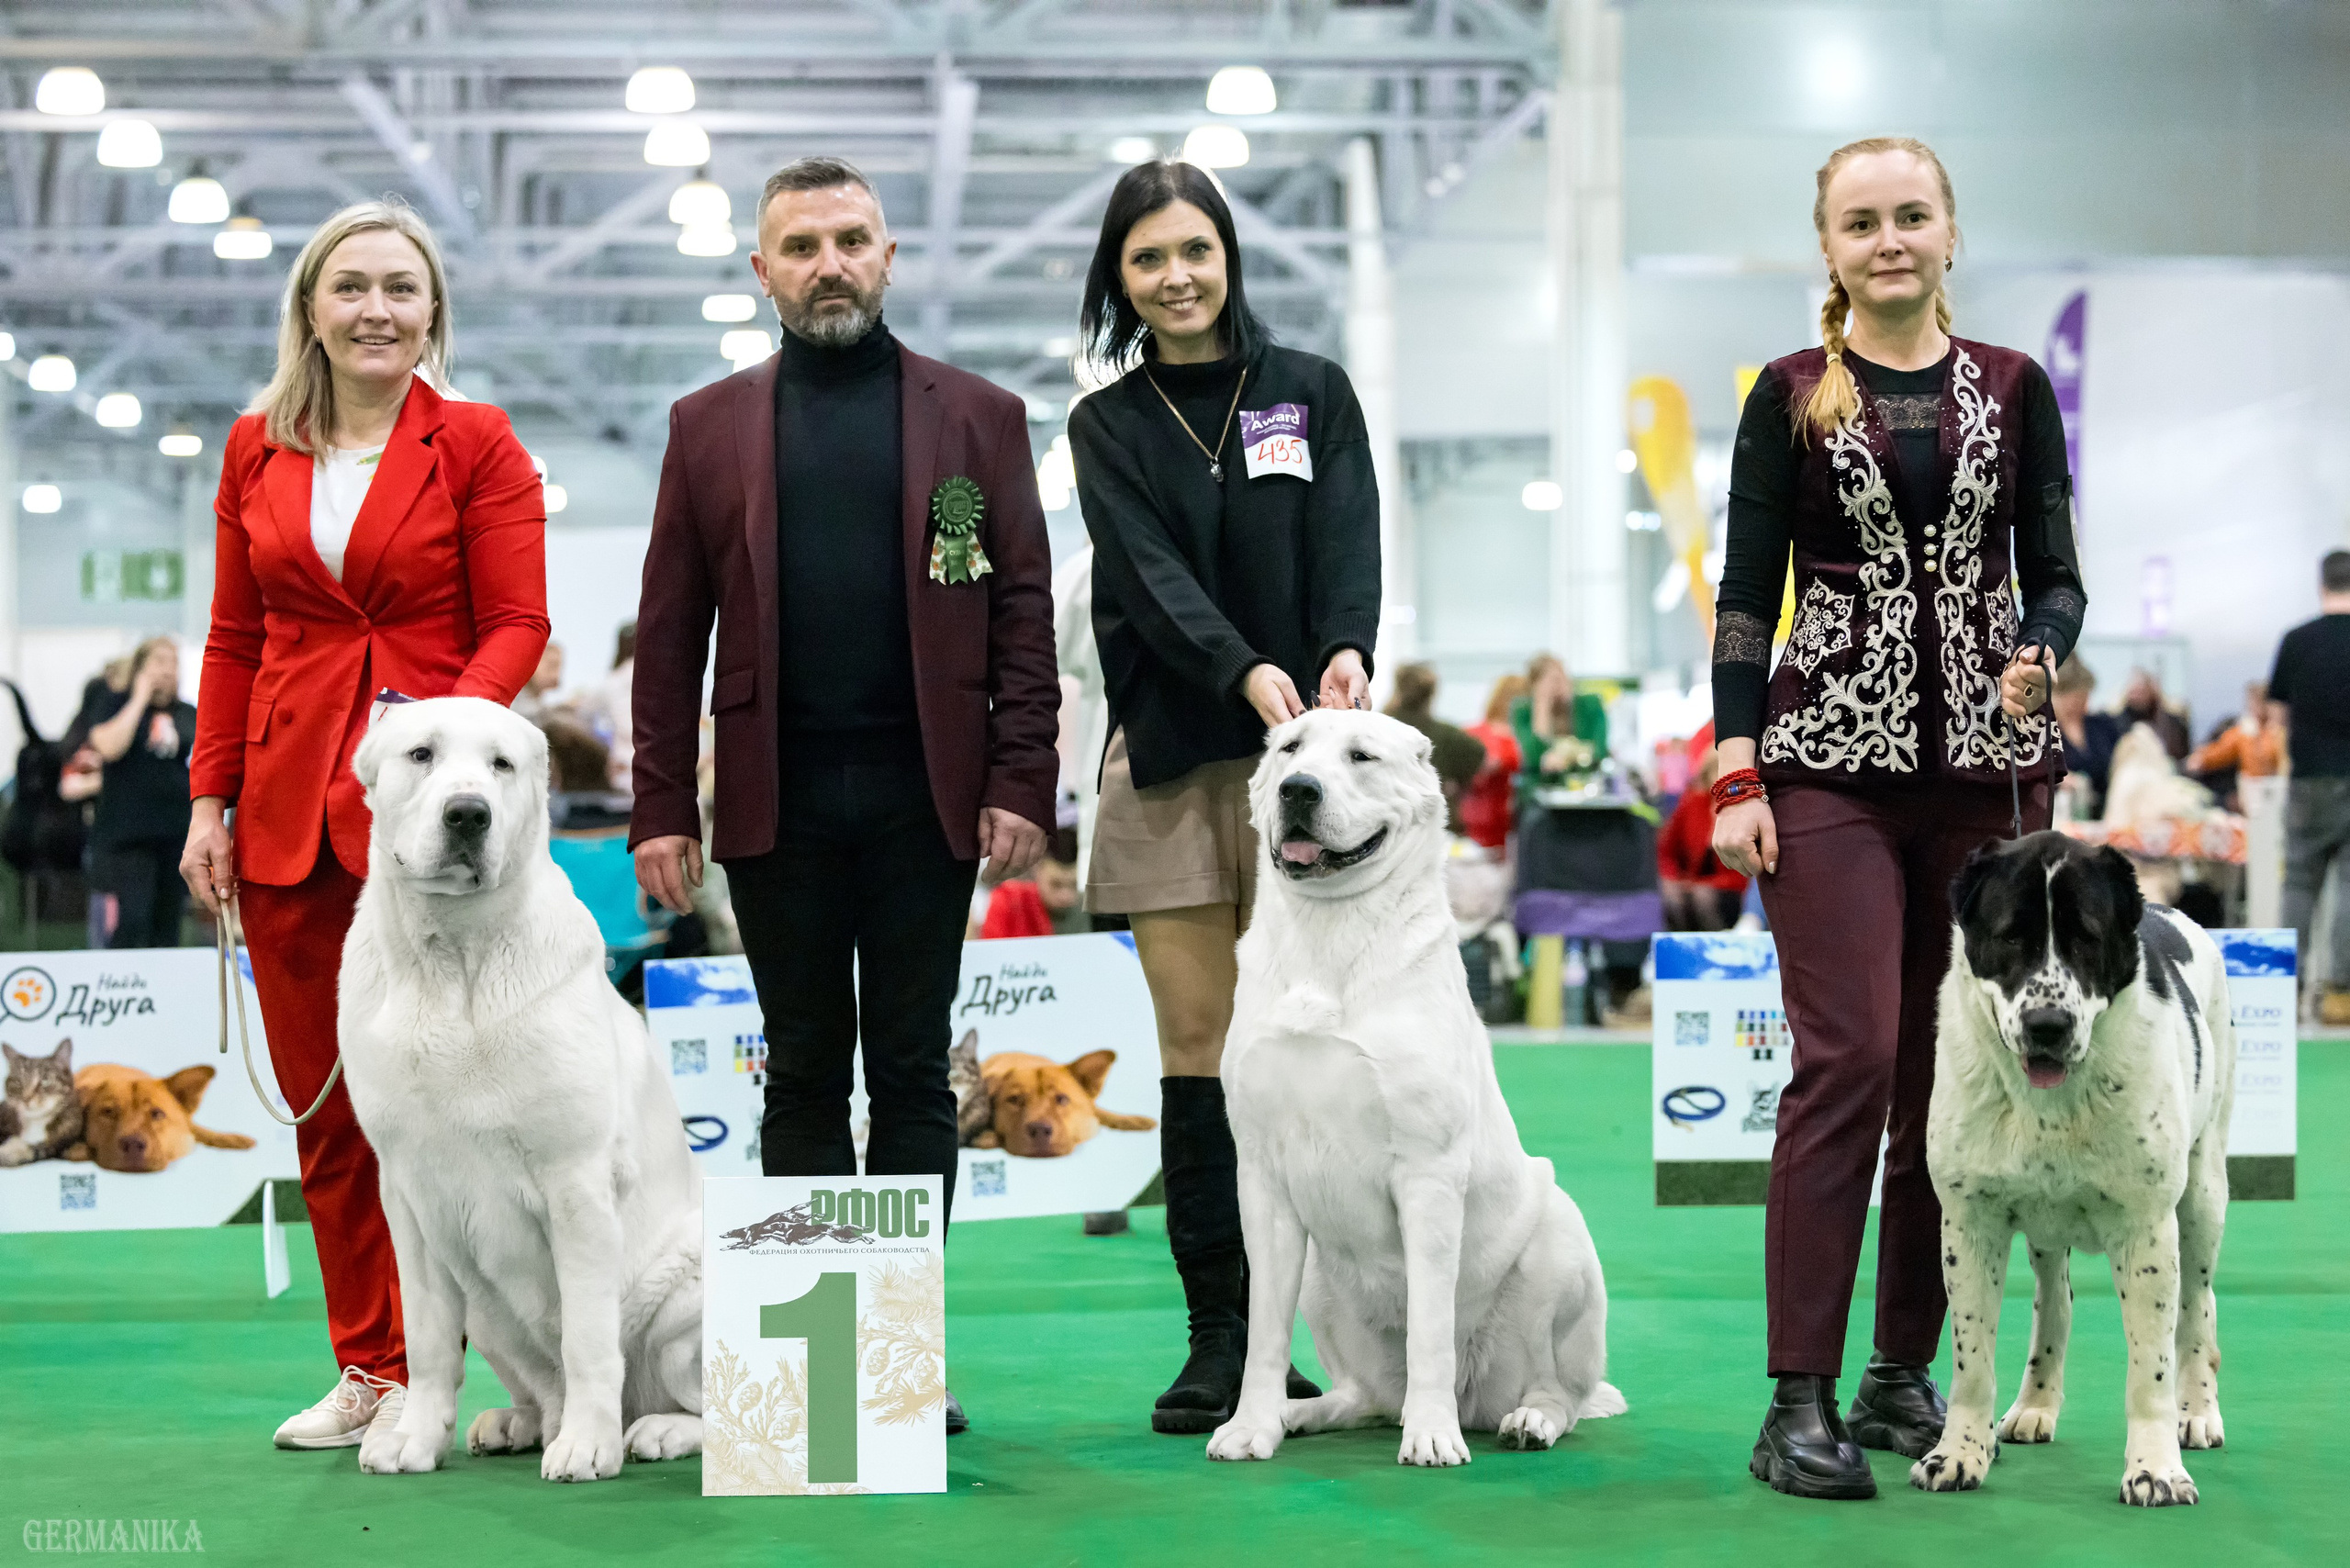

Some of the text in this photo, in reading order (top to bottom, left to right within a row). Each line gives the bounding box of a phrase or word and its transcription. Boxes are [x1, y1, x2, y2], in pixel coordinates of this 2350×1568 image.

[1251, 413, 1300, 431] Award
[1258, 438, 1303, 465] 435
[55, 984, 156, 1026] Друга
[960, 975, 1057, 1018] Друга
[811, 1188, 930, 1238] РФОС
[860, 1247, 930, 1255] СОБАКОВОДСТВА
[760, 1271, 858, 1484] 1
